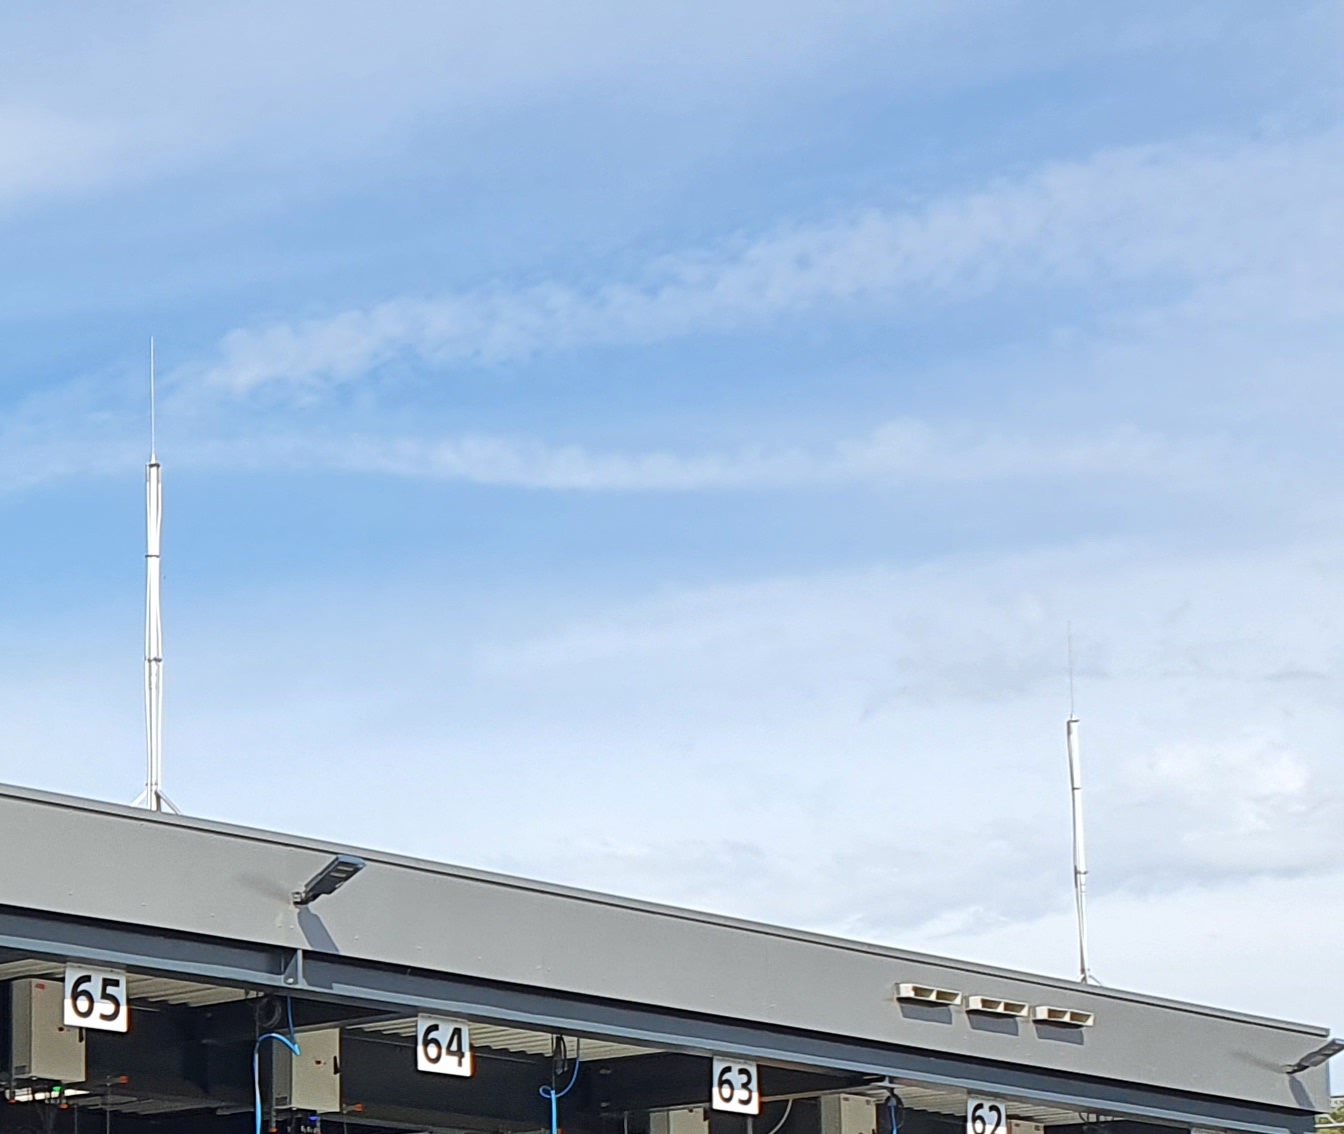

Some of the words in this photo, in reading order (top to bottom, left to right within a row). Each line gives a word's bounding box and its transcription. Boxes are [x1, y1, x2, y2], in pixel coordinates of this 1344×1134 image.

[70, 974, 121, 1022] 65
[422, 1023, 465, 1068] 64
[717, 1065, 753, 1106] 63
